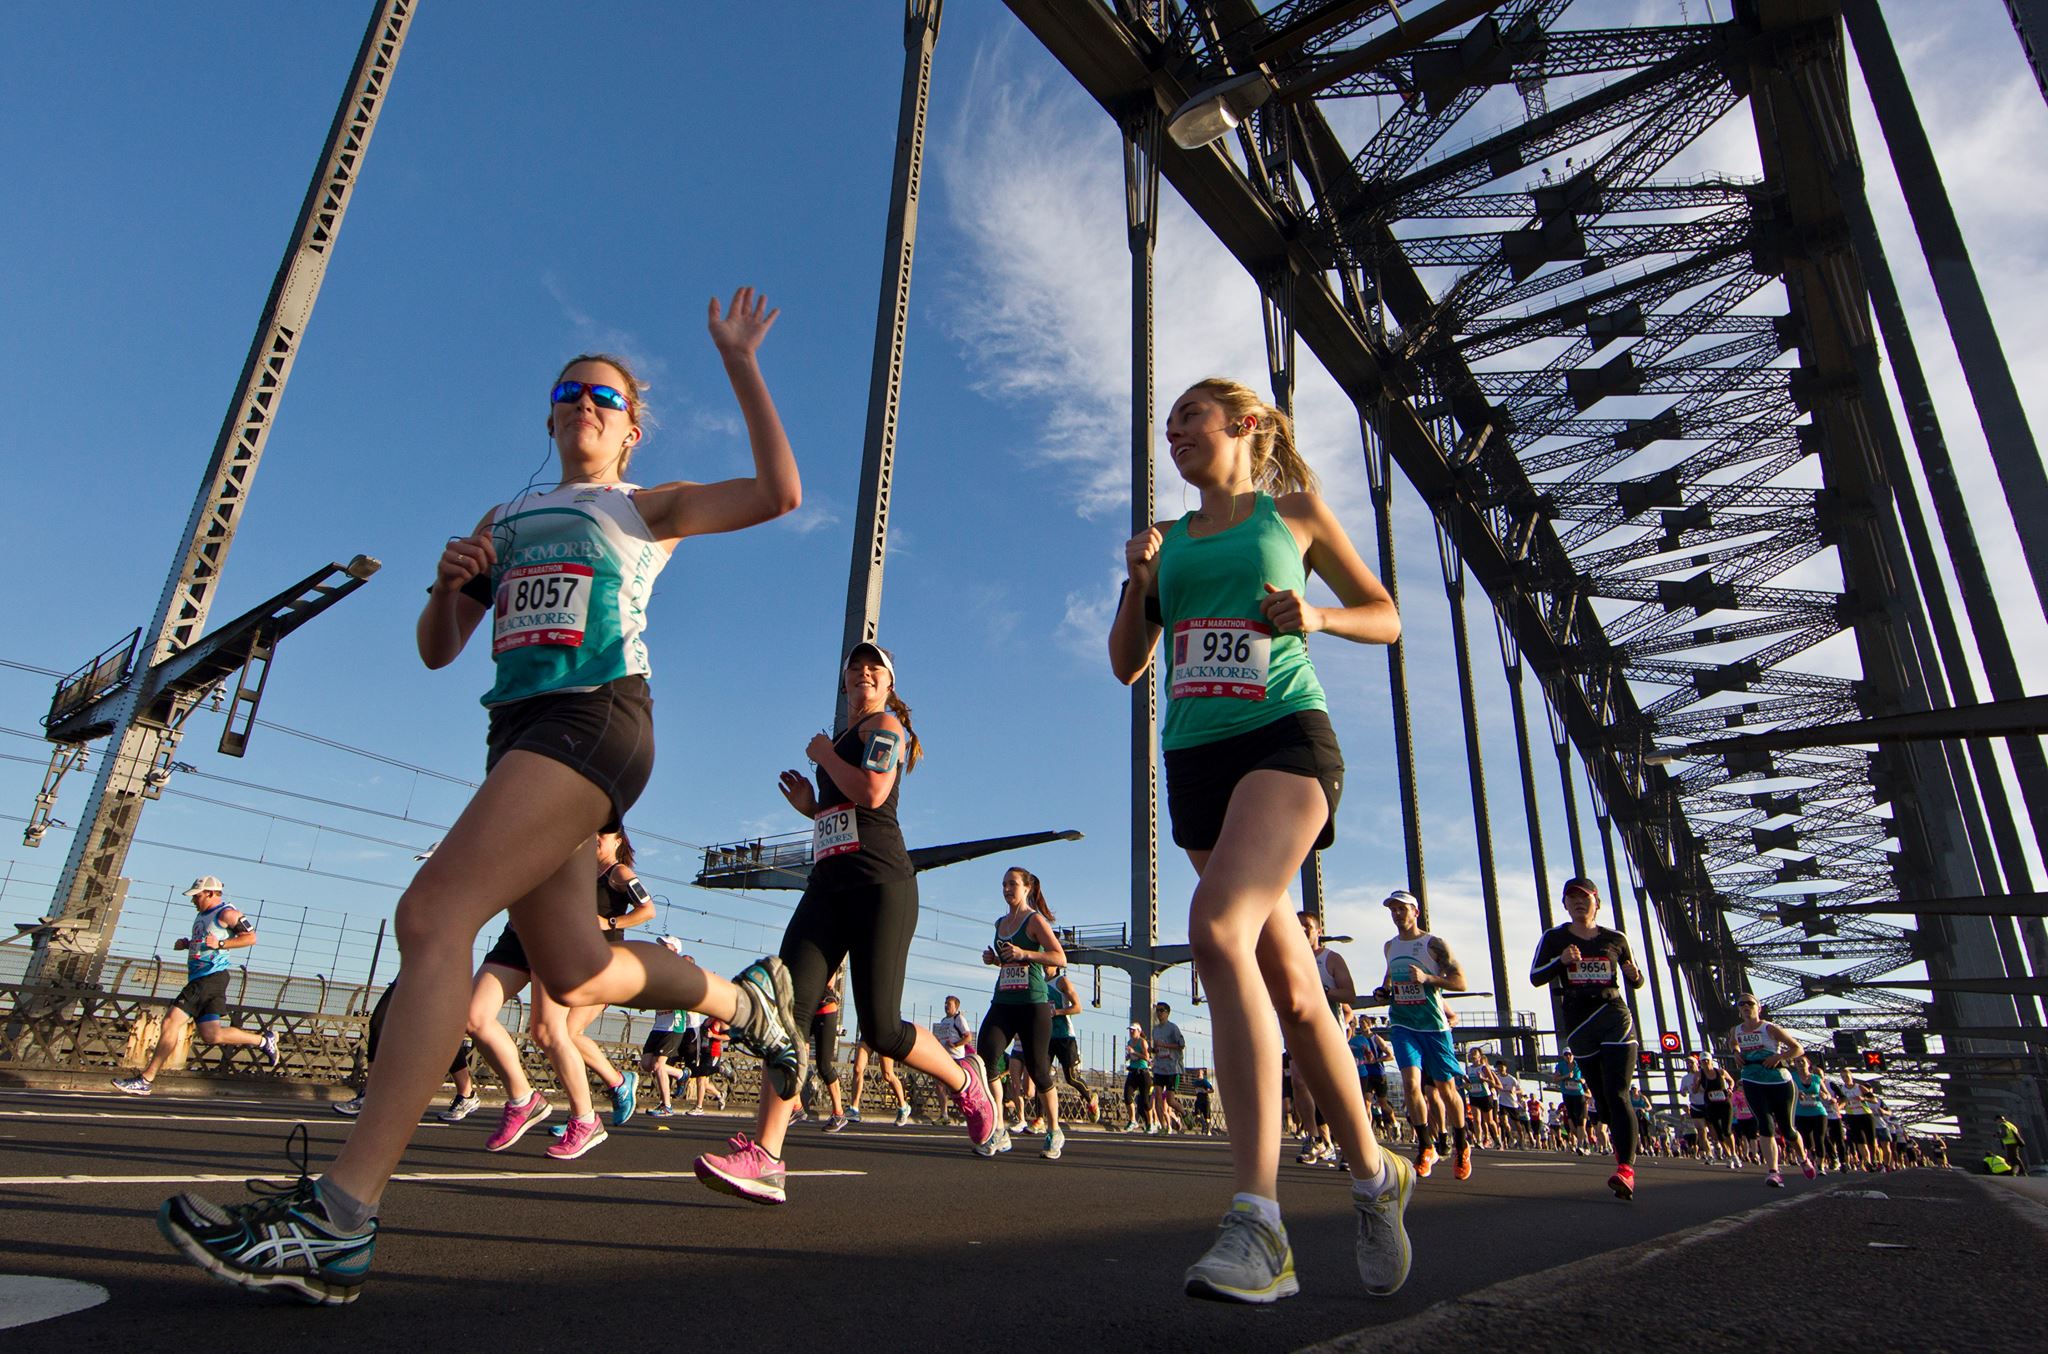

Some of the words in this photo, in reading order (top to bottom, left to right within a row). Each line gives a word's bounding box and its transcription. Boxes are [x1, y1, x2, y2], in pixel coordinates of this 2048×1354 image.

[511, 568, 527, 577] HALF
[527, 563, 564, 576] MARATHON
[514, 577, 579, 612] 8057
[1190, 619, 1207, 628] HALF
[1207, 619, 1246, 628] MARATHON
[1203, 632, 1251, 663] 936
[1175, 666, 1259, 681] BLACKMORES
[818, 812, 849, 839] 9679
[1005, 967, 1026, 978] 9045
[1580, 962, 1607, 973] 9654
[1401, 984, 1420, 995] 1485
[1665, 1038, 1675, 1046] 70
